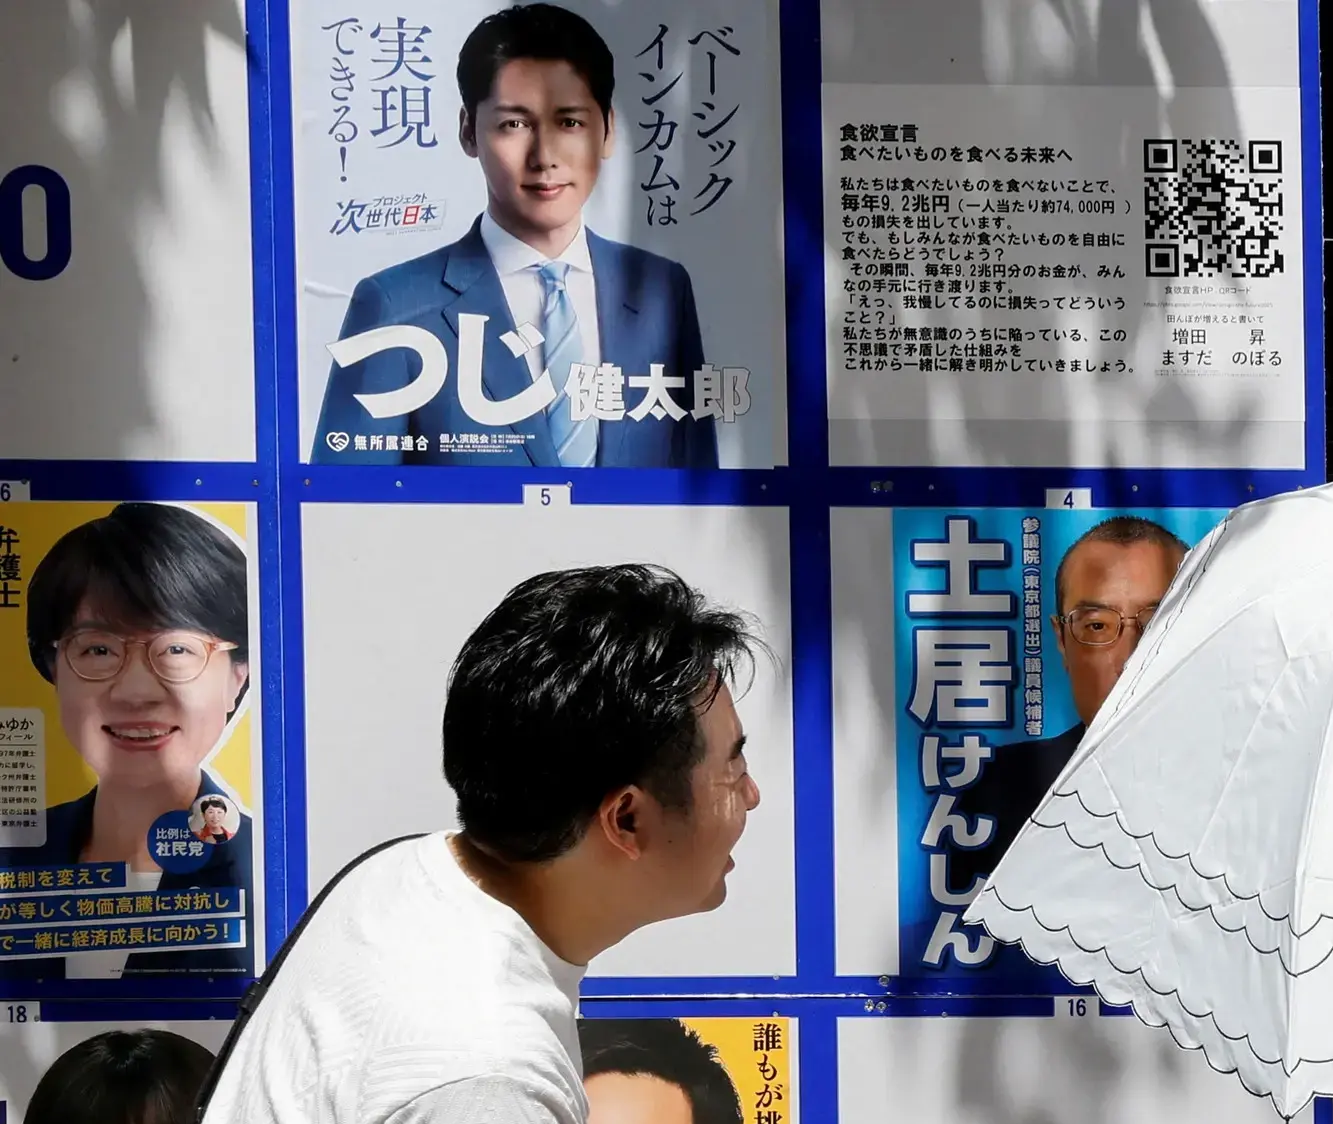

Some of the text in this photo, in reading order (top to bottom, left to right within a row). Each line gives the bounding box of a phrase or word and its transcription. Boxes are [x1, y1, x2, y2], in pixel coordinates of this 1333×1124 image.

[369, 17, 438, 149] 実現
[320, 17, 363, 183] できる!
[634, 23, 683, 227] インカムは
[689, 24, 741, 214] ベーシック
[840, 123, 919, 143] 食欲宣言
[840, 145, 1073, 163] 食べたいものを食べる未来へ
[840, 177, 1117, 194] 私たちは食べたいものを食べないことで、
[373, 193, 428, 207] プロジェクト
[329, 198, 437, 236] 次世代日本
[842, 216, 1013, 230] もの損失を出しています。
[842, 232, 1126, 247] でも、もしみんなが食べたいものを自由に
[842, 247, 1004, 261] 食べたらどうでしょう?
[843, 279, 1014, 294] なの手元に行き渡ります。
[848, 294, 1126, 310] 「えっ、我慢してるのに損失ってどういう
[843, 311, 897, 326] こと?」
[1166, 314, 1264, 323] 田んぼが増えると書いて
[843, 327, 1127, 342] 私たちが無意識のうちに陥っている、この
[1172, 328, 1265, 345] 増田 昇
[843, 343, 1022, 357] 不思議で矛盾した仕組みを
[1162, 350, 1282, 366] ますだ のぼる
[845, 357, 1136, 373] これから一緒に解き明かしていきましょう。
[354, 434, 429, 451] 無所属連合
[439, 433, 489, 445] 個人演説会
[0, 484, 11, 501] 6
[541, 489, 551, 506] 5
[1064, 491, 1075, 508] 4
[156, 828, 190, 840] 比例は
[156, 841, 204, 857] 社民党
[7, 1005, 27, 1024] 18
[1068, 999, 1087, 1016] 16
